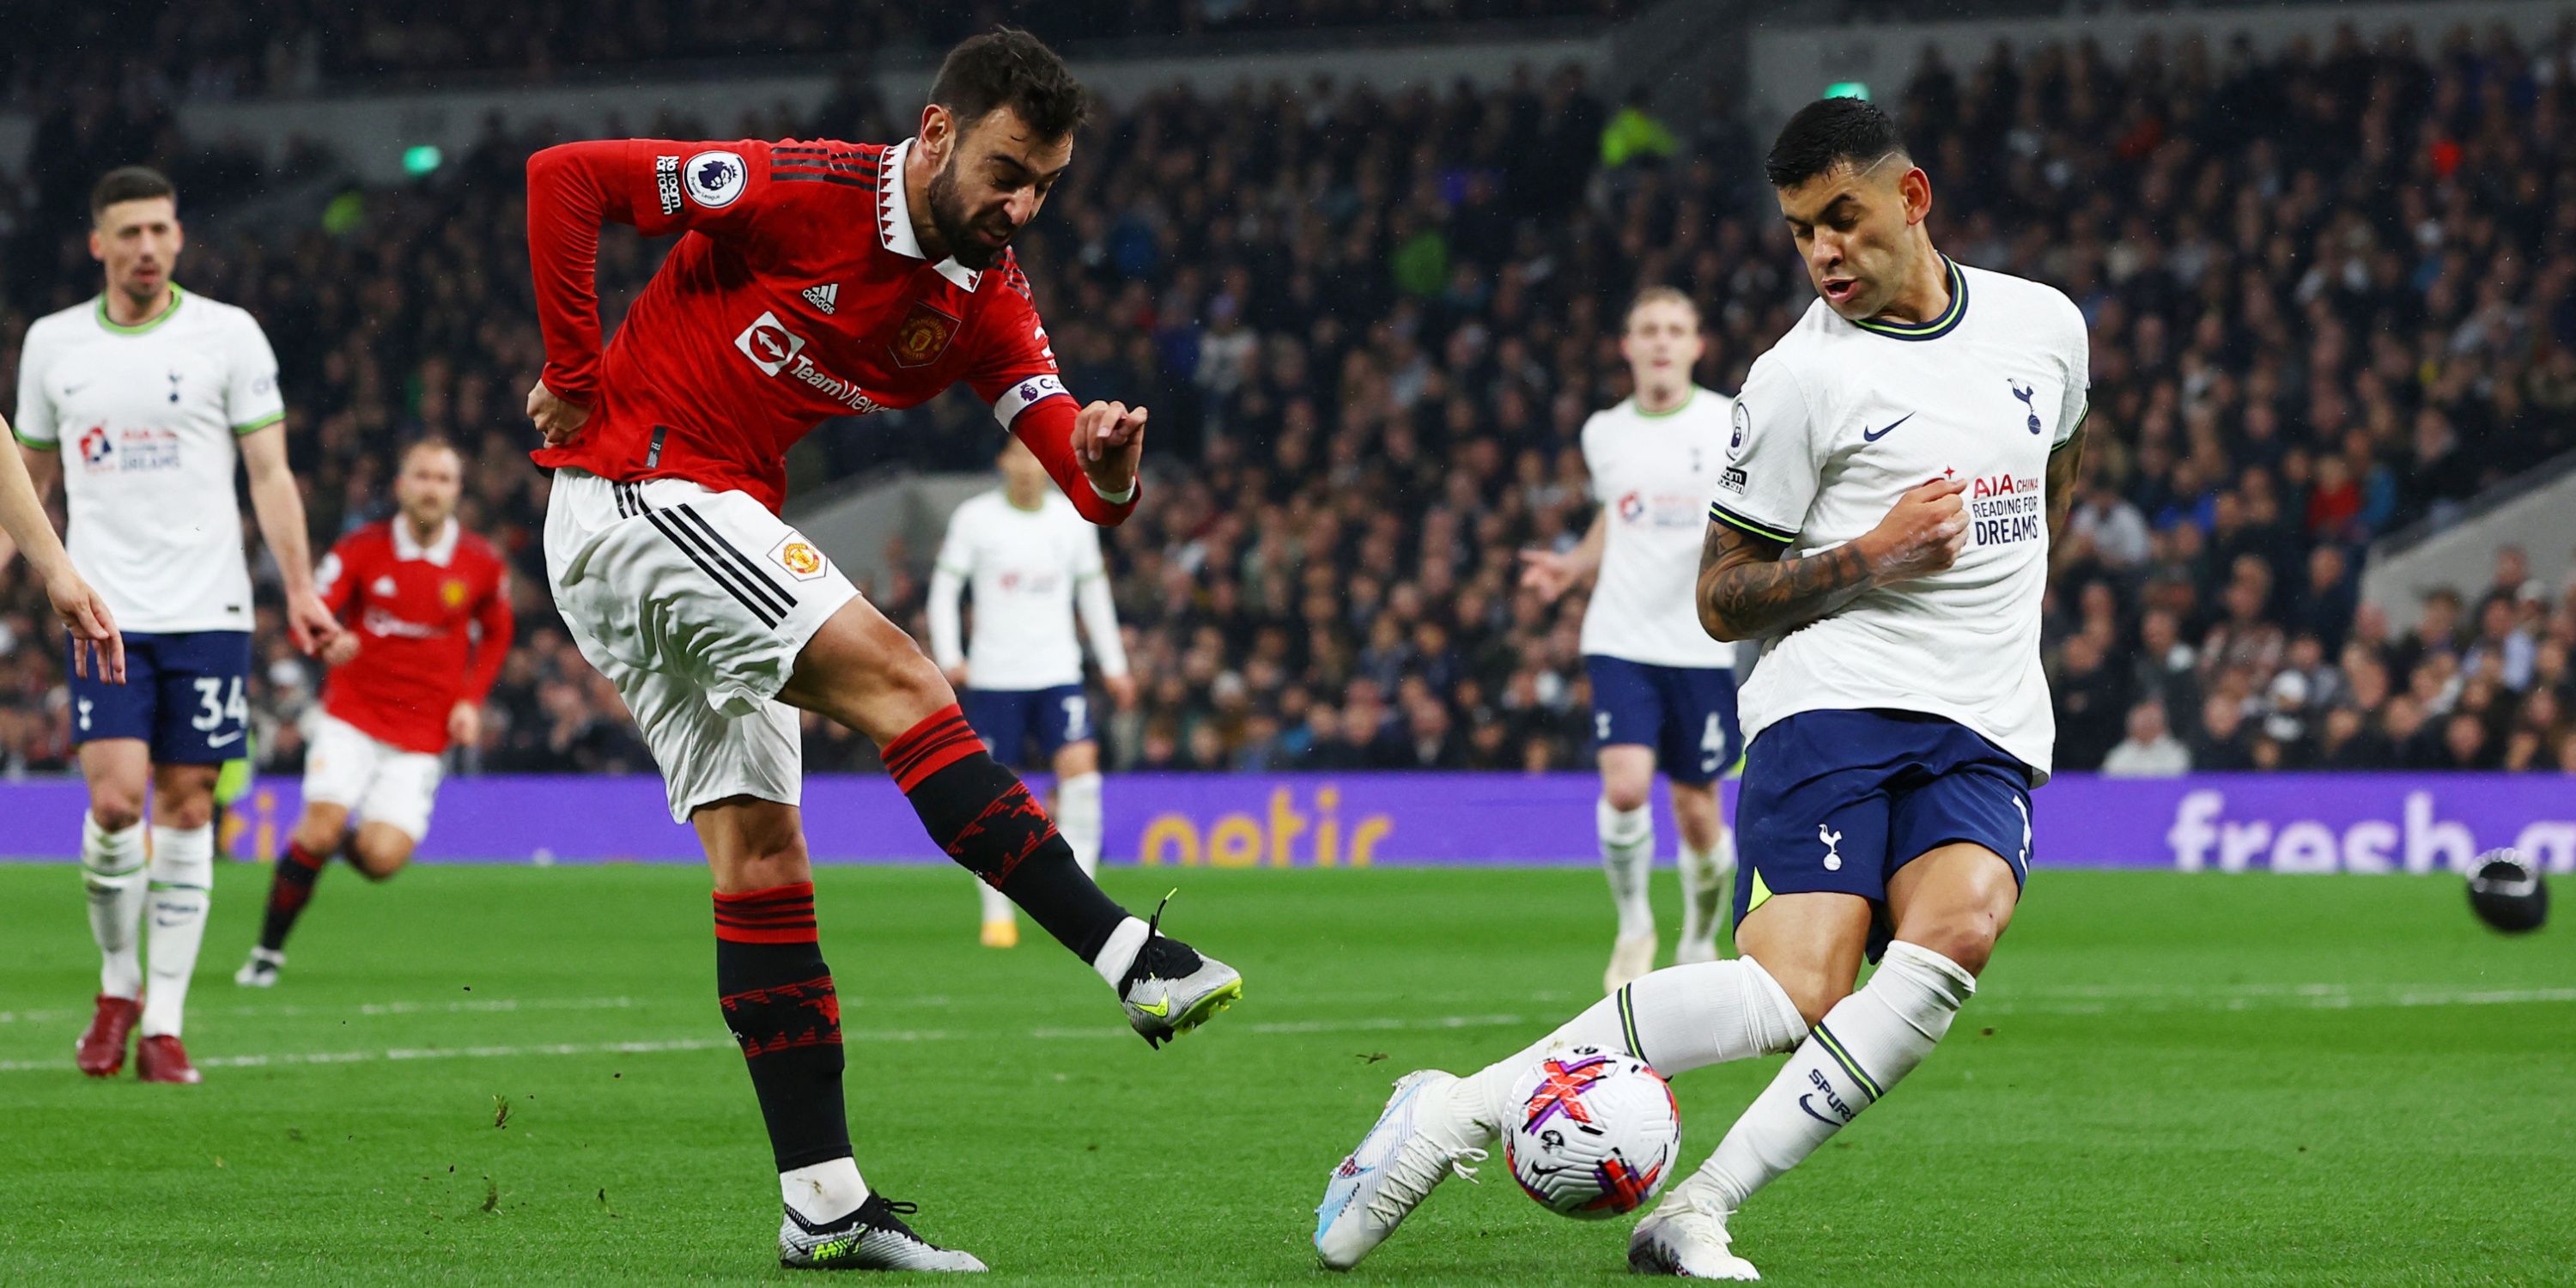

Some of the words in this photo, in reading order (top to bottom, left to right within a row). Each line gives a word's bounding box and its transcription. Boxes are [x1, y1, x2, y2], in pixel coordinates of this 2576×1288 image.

[656, 155, 665, 172] for
[666, 155, 679, 172] No
[657, 173, 672, 216] racism
[667, 173, 681, 208] room
[802, 289, 835, 315] adidas
[1973, 474, 2014, 499] AIA
[2016, 477, 2038, 494] CHINA
[1972, 498, 2021, 519] READING
[2024, 495, 2038, 513] FOR
[1975, 514, 2038, 546] DREAMS
[191, 676, 249, 732] 34
[2165, 787, 2476, 873] fresh
